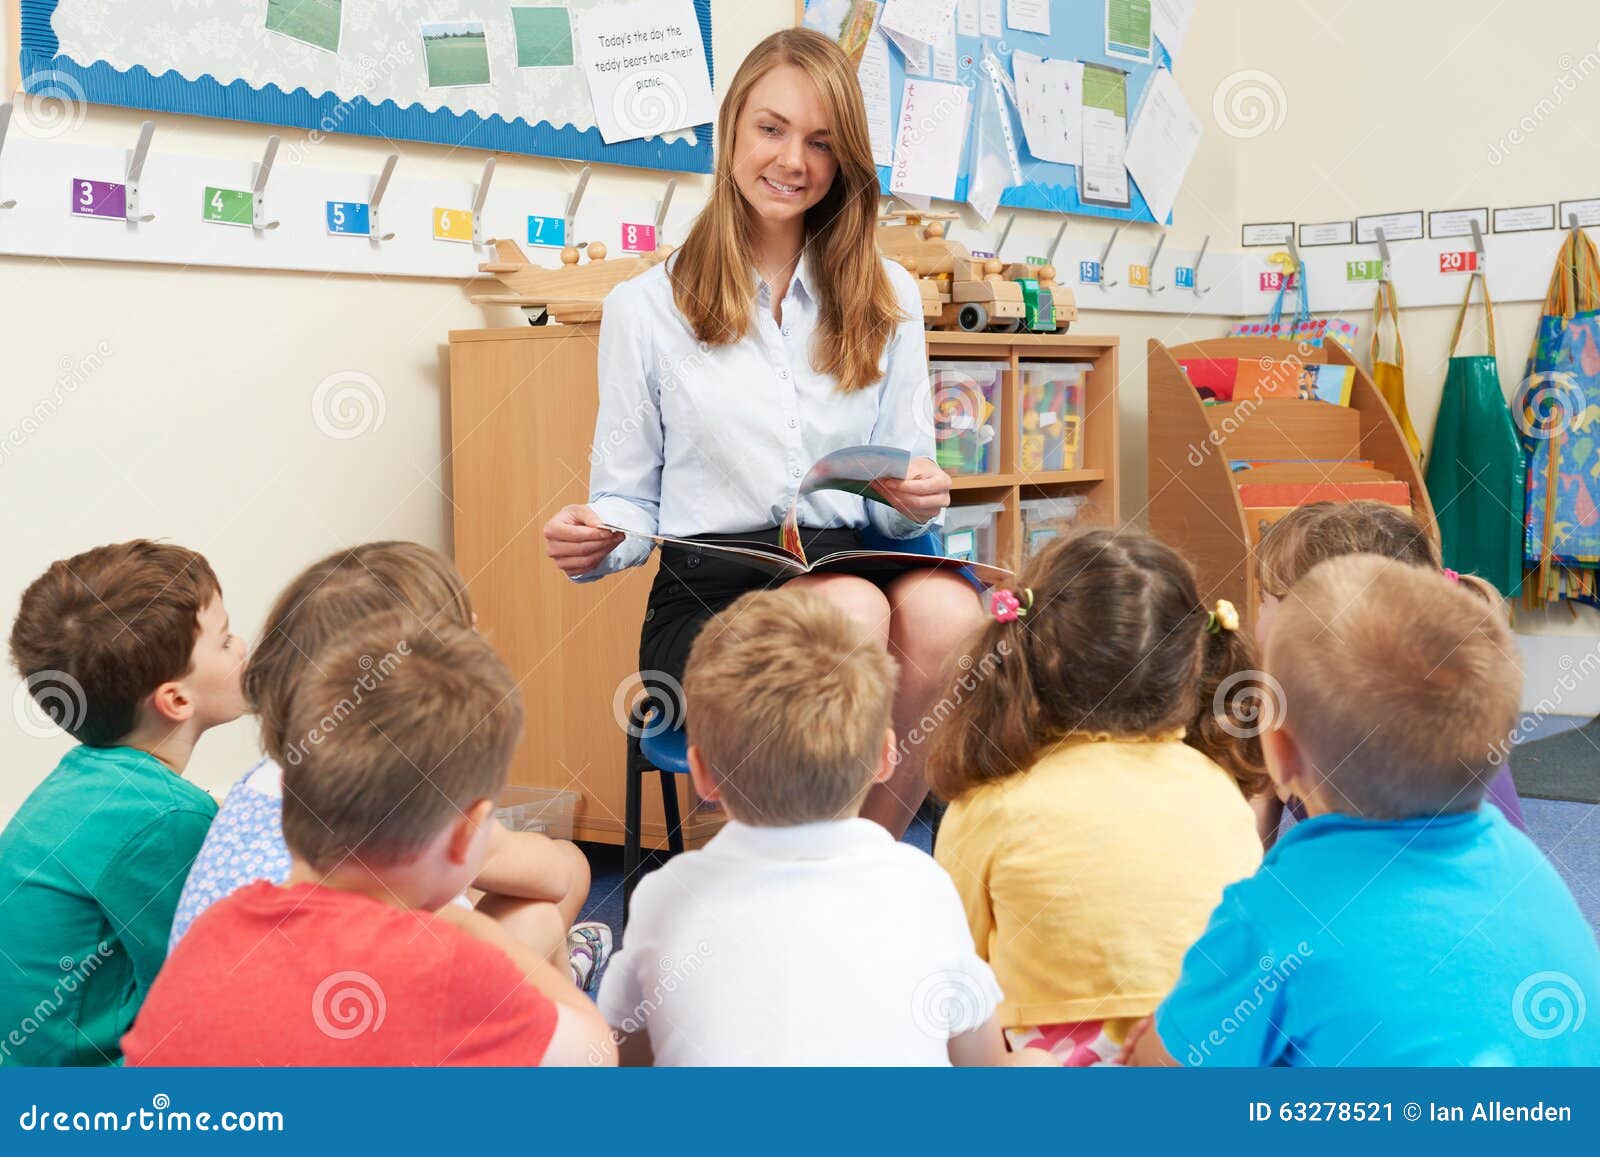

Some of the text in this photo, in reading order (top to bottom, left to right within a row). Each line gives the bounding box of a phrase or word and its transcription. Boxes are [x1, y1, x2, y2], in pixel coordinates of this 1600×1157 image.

[597, 24, 682, 48] Today's the day the
[595, 46, 693, 72] teddy bears have their
[636, 76, 665, 92] picnic.
[80, 182, 93, 205] 3
[211, 191, 224, 212] 4
[334, 203, 345, 224] 5
[441, 210, 451, 230] 6
[534, 217, 544, 237] 7
[627, 225, 637, 244] 8
[1082, 262, 1093, 277] 15
[1350, 262, 1367, 276] 19
[1442, 253, 1461, 268] 20
[1177, 269, 1187, 282] 17
[1263, 274, 1279, 287] 18
